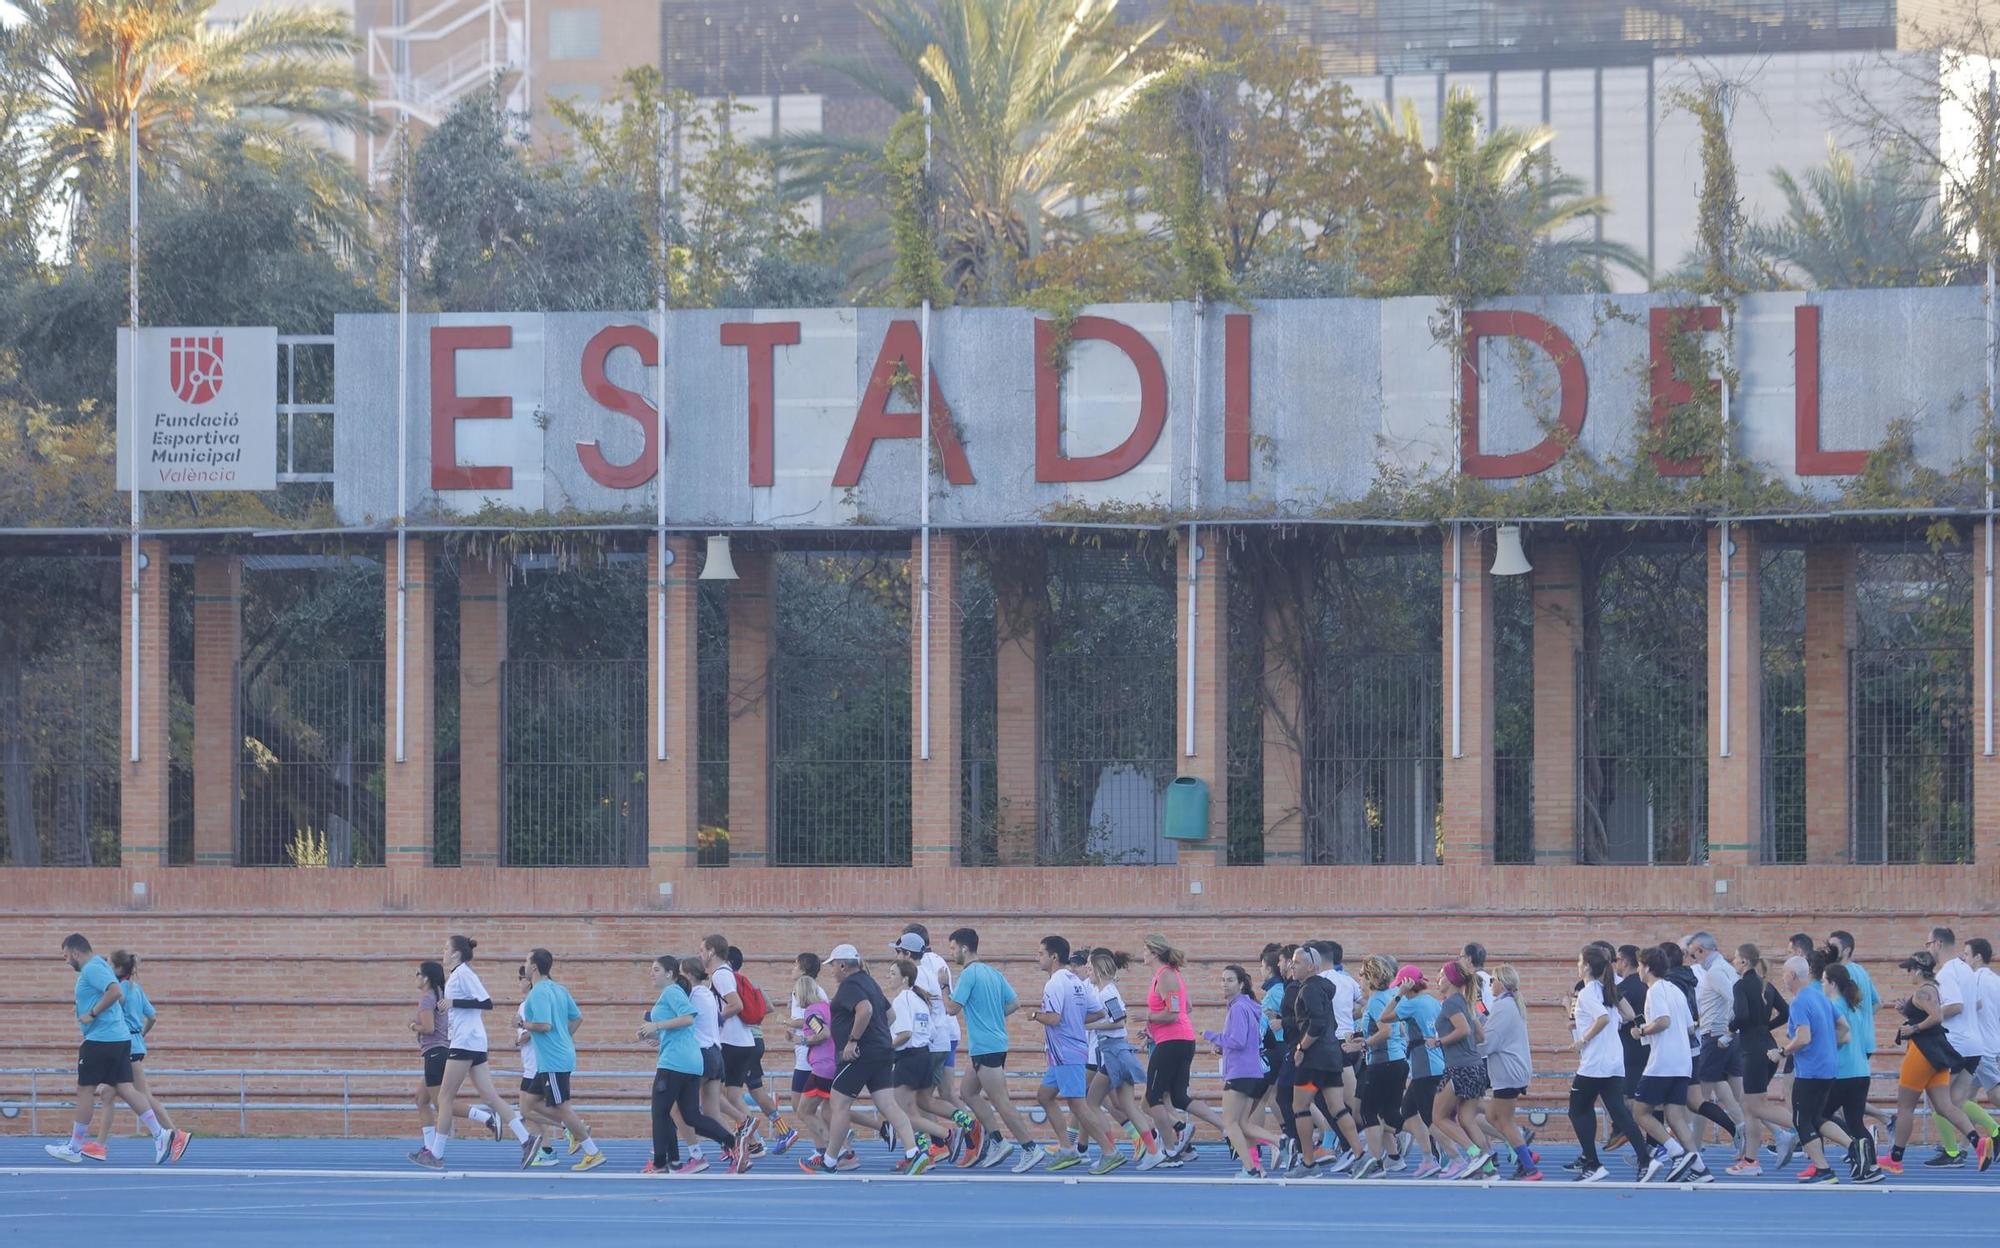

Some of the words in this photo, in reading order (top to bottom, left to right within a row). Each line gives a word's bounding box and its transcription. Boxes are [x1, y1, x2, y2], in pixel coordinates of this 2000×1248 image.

[430, 314, 1252, 490] ESTADI
[1460, 305, 1873, 478] DEL
[154, 411, 239, 428] Fundació
[152, 429, 240, 449] Esportiva
[151, 447, 241, 467] Municipal
[159, 467, 236, 483] València
